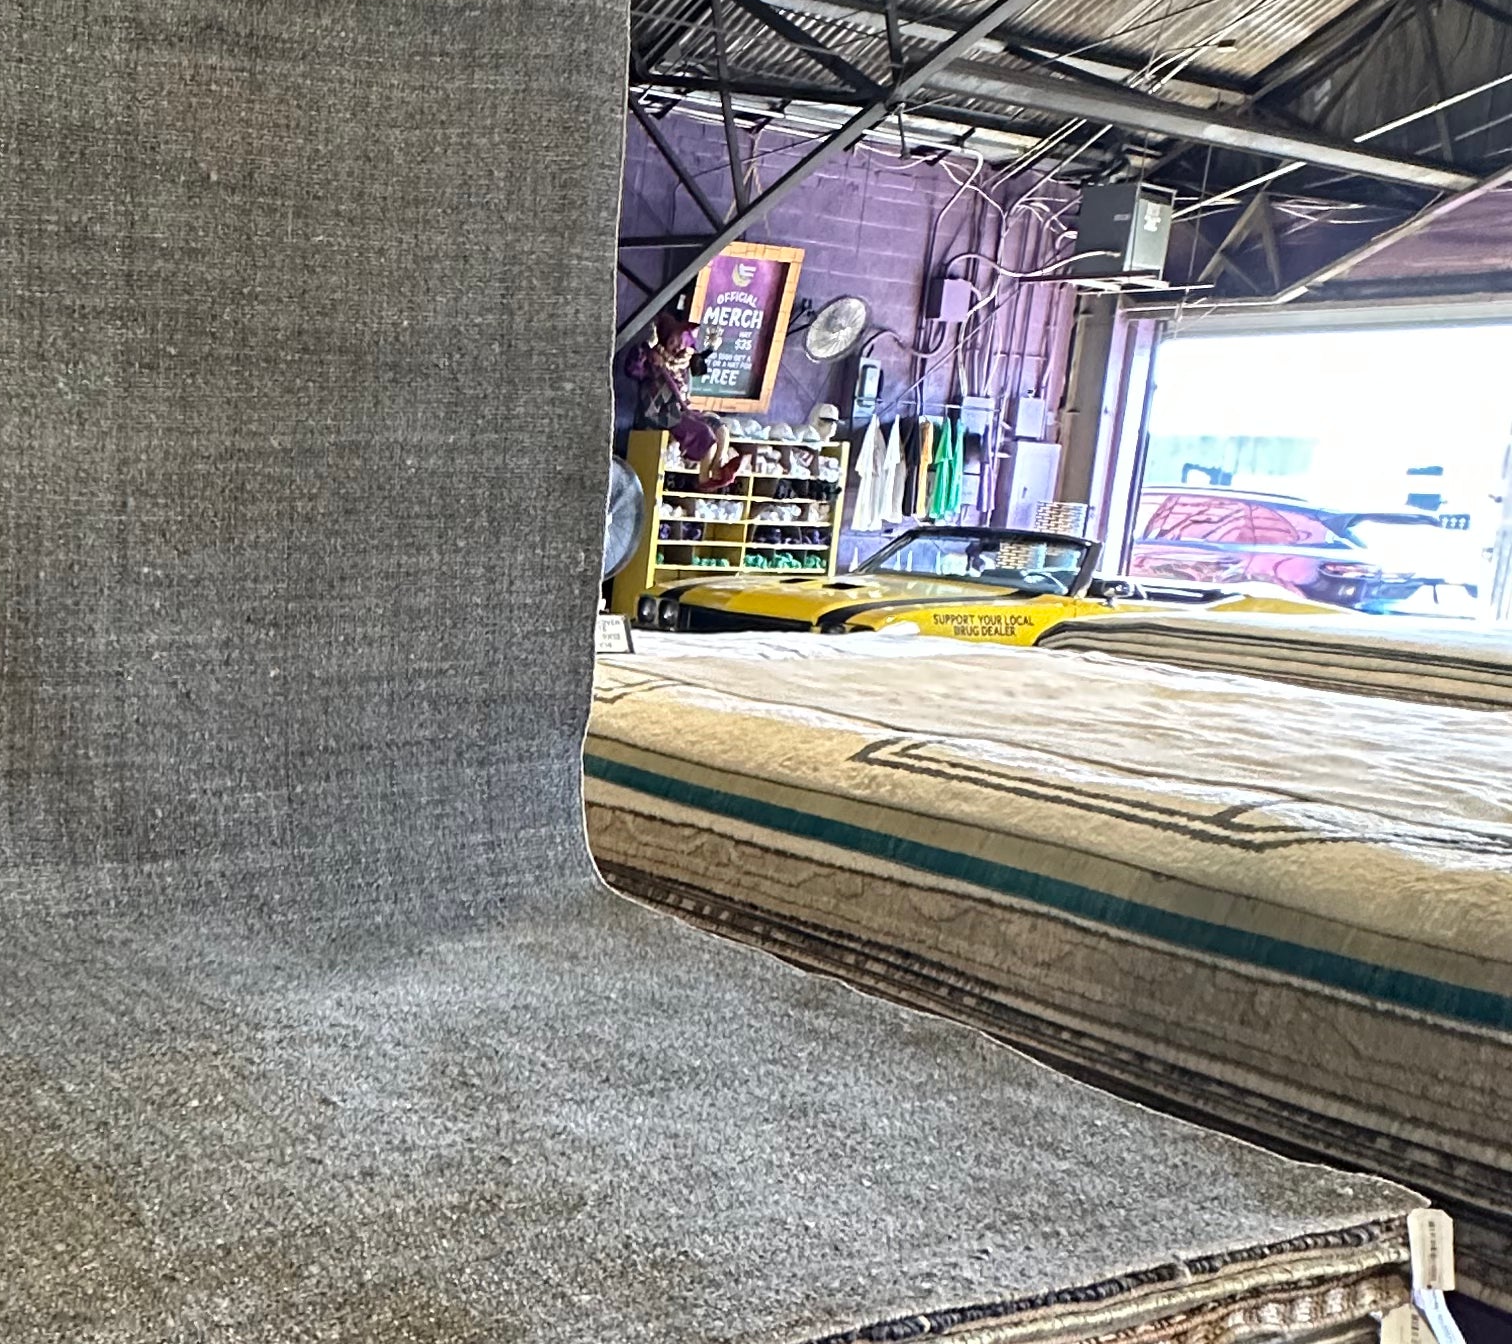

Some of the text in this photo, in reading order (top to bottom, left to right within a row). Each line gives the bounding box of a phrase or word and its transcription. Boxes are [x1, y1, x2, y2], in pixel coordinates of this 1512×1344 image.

[717, 292, 757, 308] OFFICIAL
[703, 307, 763, 329] MERCH
[701, 368, 740, 385] FREE
[933, 614, 1034, 626] SUPPORT YOUR LOCAL
[953, 626, 1016, 636] DRUG DEALER
